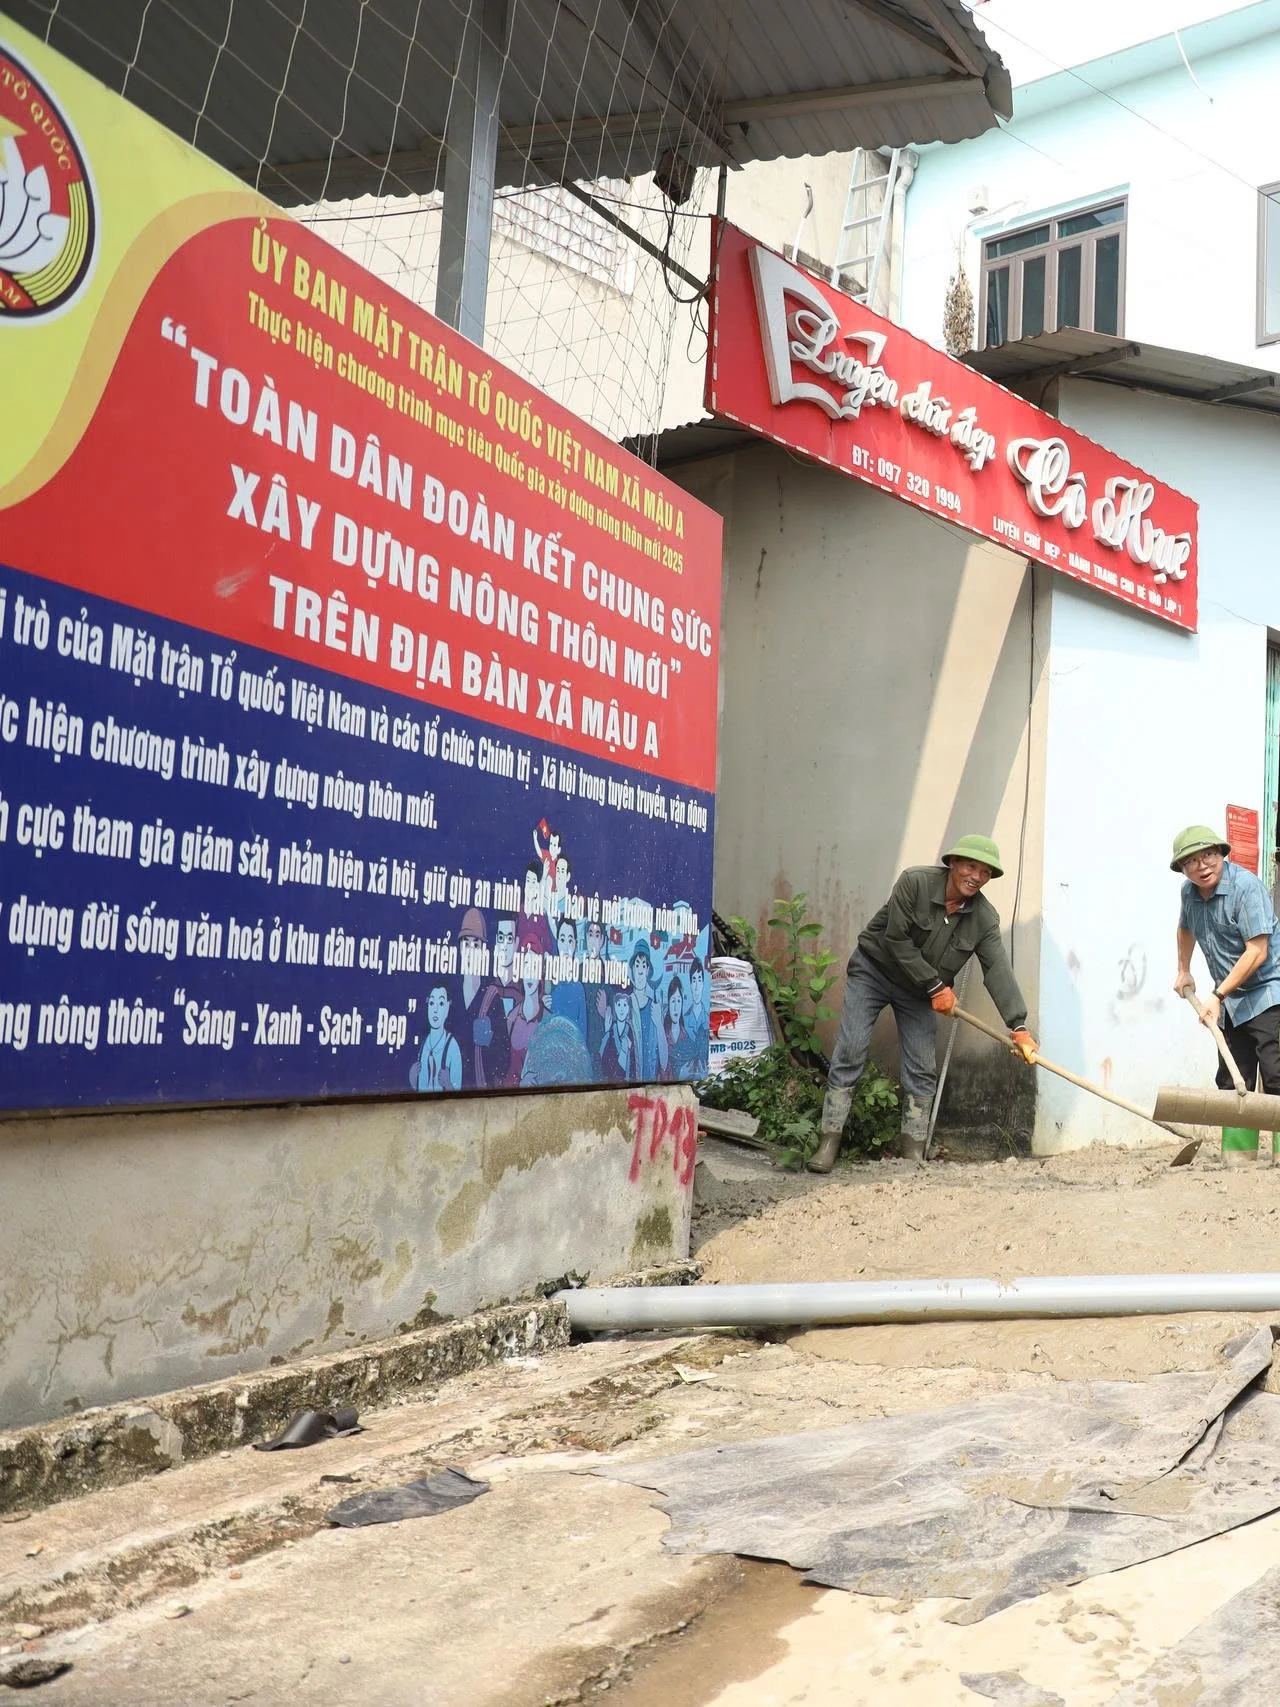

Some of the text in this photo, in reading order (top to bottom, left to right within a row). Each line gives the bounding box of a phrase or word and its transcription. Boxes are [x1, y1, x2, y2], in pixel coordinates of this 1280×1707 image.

[249, 290, 683, 575] Thực hiện chương trình mục tiêu Quốc gia xây dựng nông thôn mới 2025
[251, 217, 684, 540] ỦY BAN MẶT TRẬN TỔ QUỐC VIỆT NAM XÃ MẬU A
[951, 406, 995, 472] đẹp
[852, 444, 961, 513] ĐT: 097 320 1994
[1006, 437, 1088, 529] Cô
[226, 463, 321, 550] XÂY
[332, 512, 440, 604] DỰNG
[449, 566, 539, 646] NÔNG
[547, 610, 617, 678] THÔN
[330, 423, 413, 510] DÂN
[423, 474, 515, 561] ĐOÀN
[523, 528, 575, 590] KẾT
[582, 560, 665, 635] CHUNG
[671, 607, 712, 657] SỨC
[1093, 563, 1118, 587] TRANG
[13, 594, 50, 650] trò
[57, 606, 104, 665] của
[109, 623, 156, 687] Mặt
[160, 639, 204, 699] trận
[210, 649, 238, 701] Tổ
[238, 665, 286, 716] quốc
[291, 678, 325, 733] Việt
[327, 690, 367, 739] Nam
[370, 704, 389, 745] và
[392, 712, 420, 753] các
[424, 714, 441, 758] tổ
[441, 727, 475, 767] chức
[477, 735, 514, 779] Chính
[517, 748, 531, 790] trị
[541, 754, 557, 790] Xã
[558, 759, 577, 801] hội
[578, 767, 606, 808] trong
[608, 775, 635, 812] tuyên
[669, 795, 686, 829] vận
[687, 799, 708, 833] động
[269, 575, 659, 759] TRÊN ĐỊA BÀN XÃ MẬU A
[26, 696, 84, 763] hiện
[90, 714, 176, 781] chương
[181, 735, 230, 787] trình
[234, 749, 271, 800] xây
[274, 757, 319, 810] dựng
[322, 769, 365, 820] nông
[368, 779, 403, 823] thôn
[405, 790, 438, 830] mới.
[16, 803, 65, 859] cực
[72, 805, 134, 860] tham
[139, 818, 176, 868] gia
[180, 824, 234, 873] giám
[238, 833, 273, 885] sát,
[277, 838, 323, 886] phản
[327, 848, 364, 899] biện
[367, 856, 388, 895] xã
[391, 858, 419, 906] hội,
[423, 864, 448, 906] giữ
[449, 867, 470, 909] gìn
[474, 878, 490, 909] an
[494, 877, 521, 913] ninh
[8, 895, 74, 957] dựng
[80, 901, 120, 951] đời
[124, 901, 180, 960] sống
[185, 911, 223, 959] văn
[227, 916, 264, 961] hoá
[269, 916, 282, 963] ở
[285, 923, 320, 965] khu
[323, 926, 355, 968] dân
[358, 935, 383, 975] cư,
[387, 934, 421, 975] phát
[424, 930, 458, 975] triển
[37, 994, 101, 1050] nông
[107, 996, 165, 1045] thôn:
[253, 1002, 302, 1045] Xanh
[318, 1005, 362, 1054] Sạch
